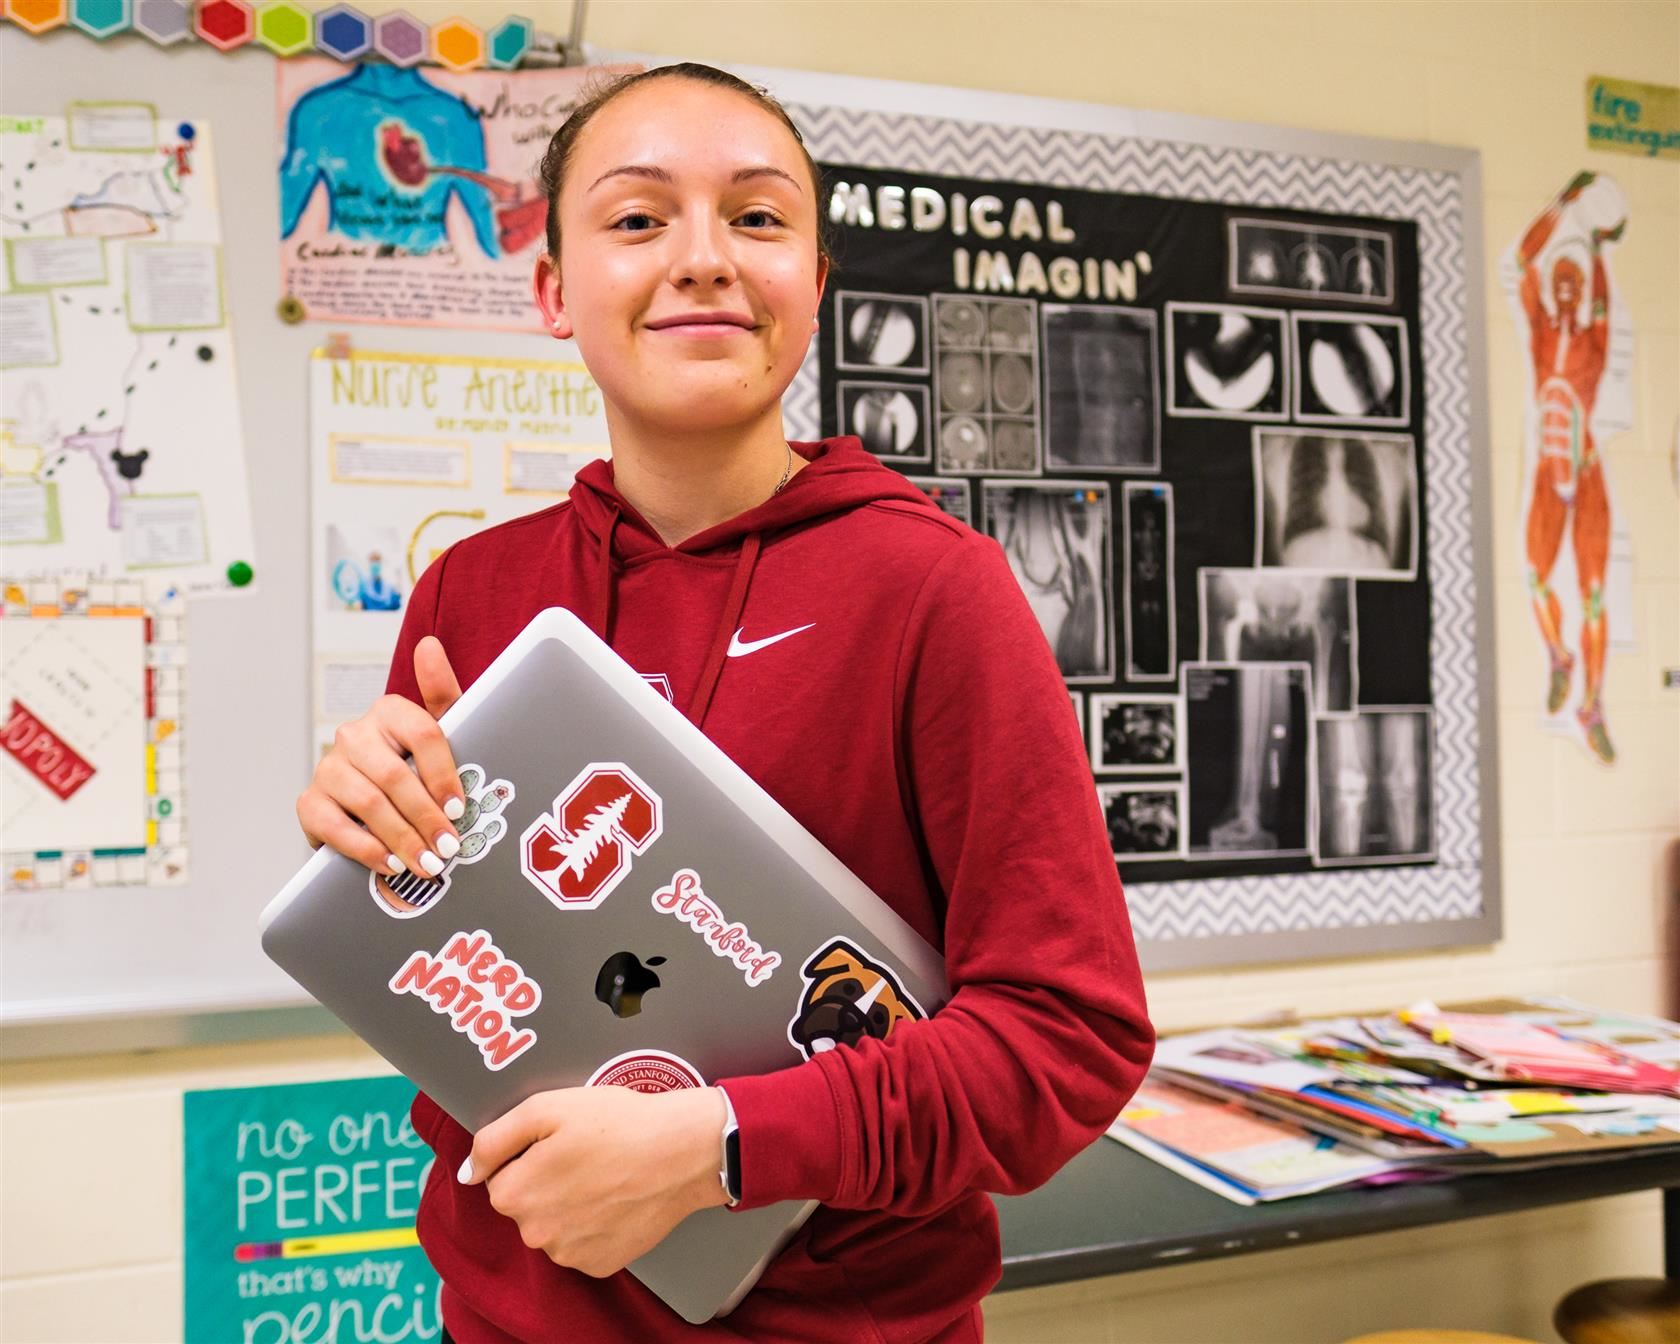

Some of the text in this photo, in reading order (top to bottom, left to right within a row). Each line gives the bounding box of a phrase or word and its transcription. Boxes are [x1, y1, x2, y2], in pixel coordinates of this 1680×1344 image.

[1593, 83, 1641, 124] fire
[829, 181, 1076, 243] MEDICAL
[952, 248, 1152, 300] IMAGIN'
[331, 360, 600, 417] Nurse Anesthe
[656, 873, 777, 980] Stanford
[445, 936, 536, 1010] NERD
[395, 956, 532, 1065] NATION
[628, 1069, 676, 1085] STANFORD
[236, 1111, 427, 1162] no one
[237, 1257, 404, 1298] that's why
